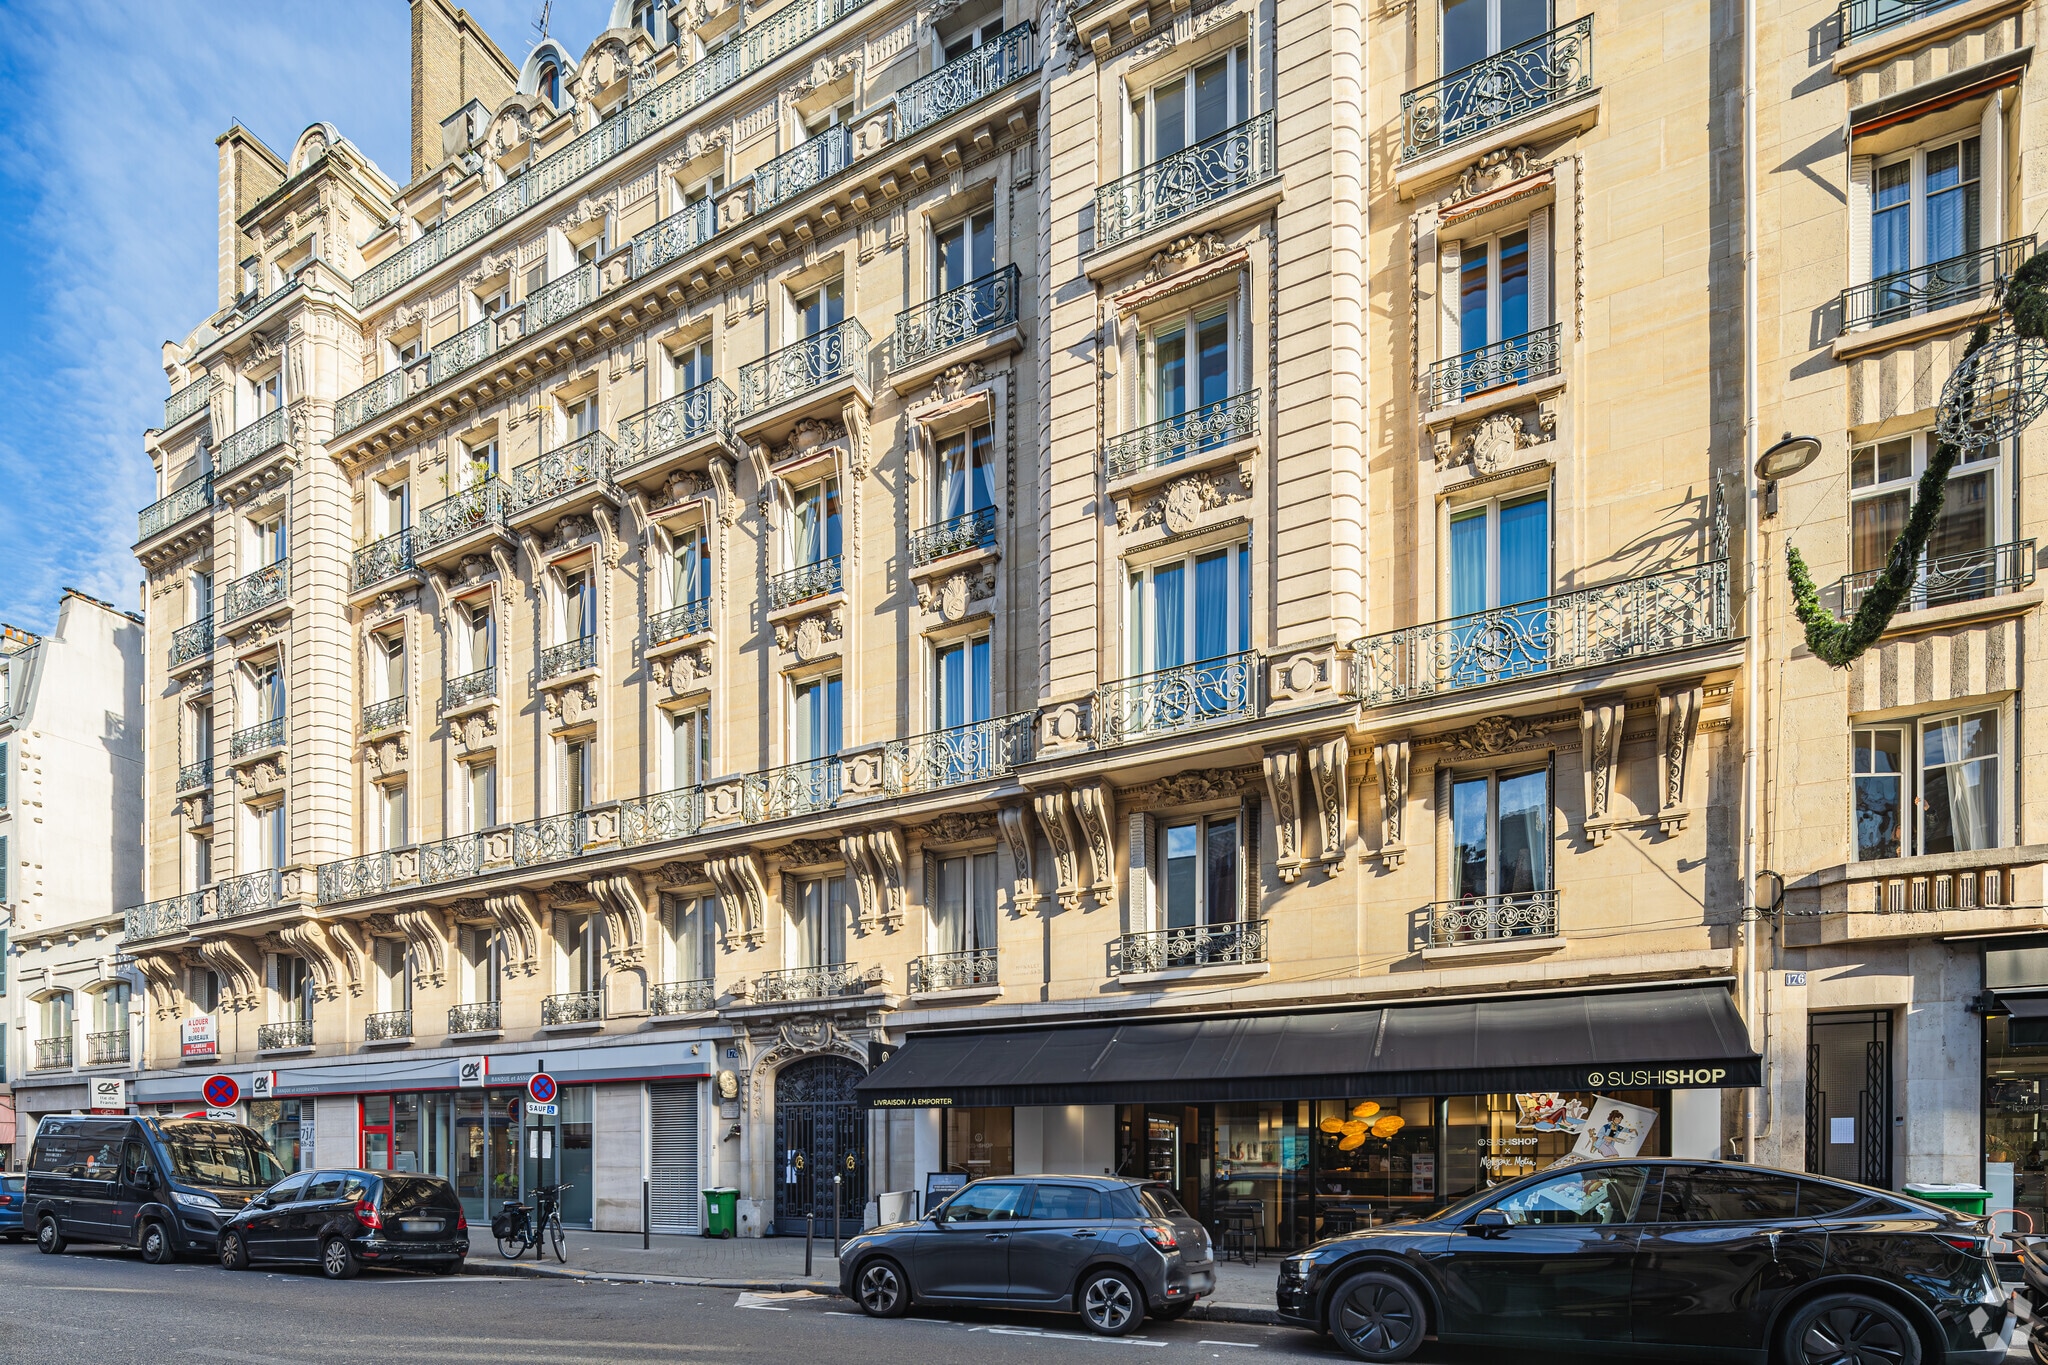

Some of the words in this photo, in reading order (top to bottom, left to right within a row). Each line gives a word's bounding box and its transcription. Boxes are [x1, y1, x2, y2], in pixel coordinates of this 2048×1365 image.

[1787, 974, 1805, 985] 176
[193, 1018, 209, 1026] LOUER
[1607, 1068, 1726, 1087] SUSHISHOP
[911, 1097, 917, 1105] À
[1486, 1138, 1538, 1147] SUSHISHOP
